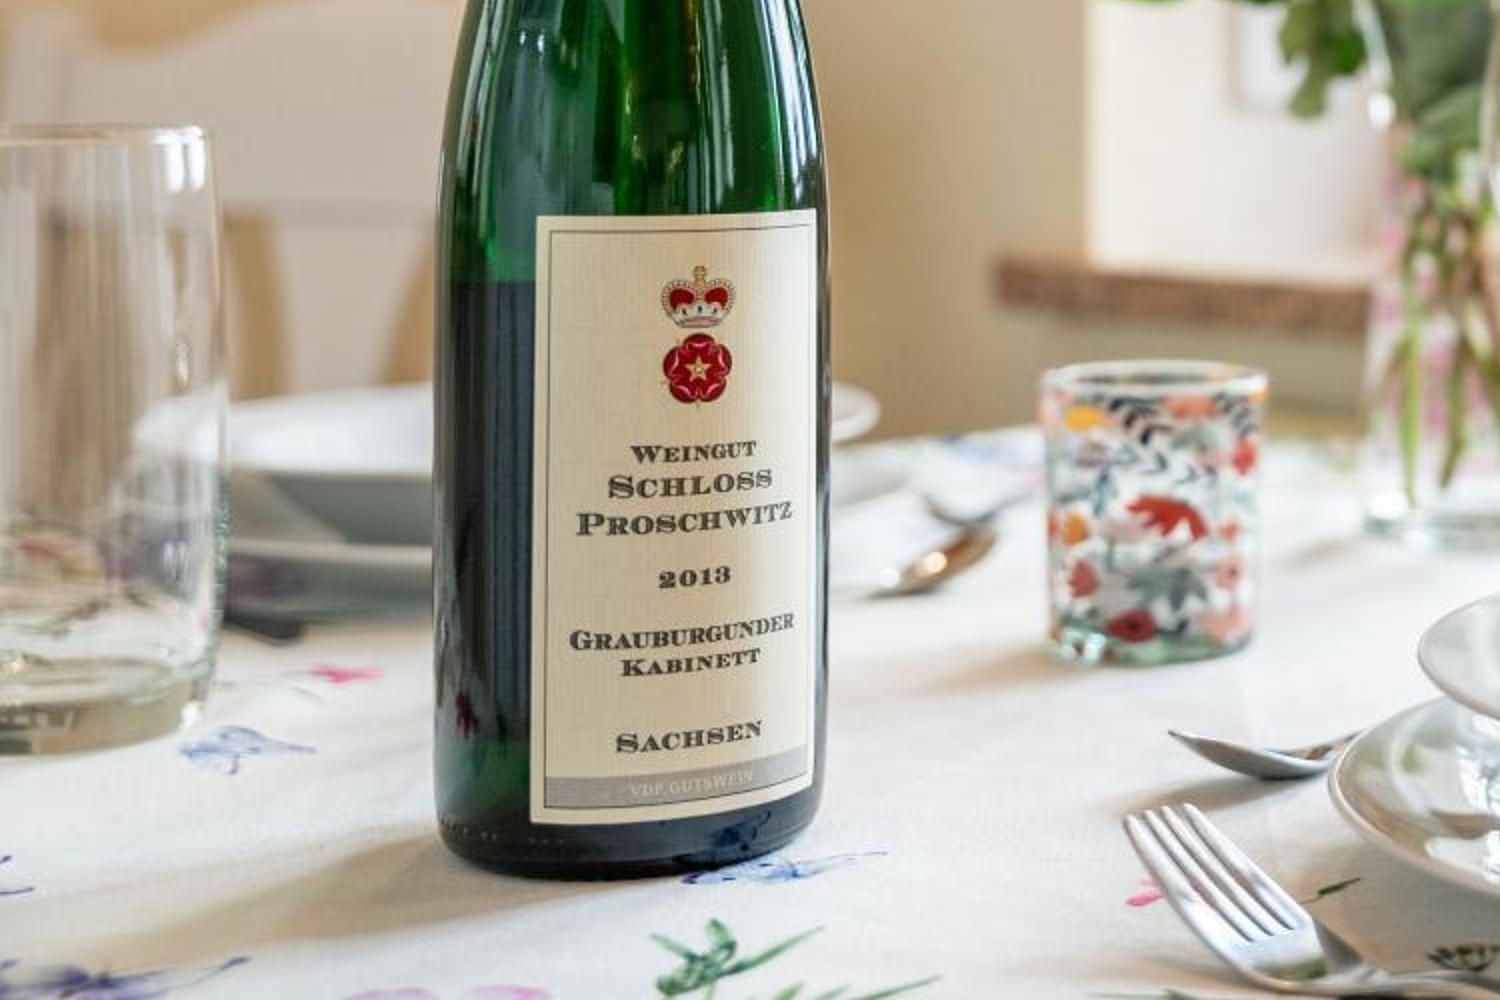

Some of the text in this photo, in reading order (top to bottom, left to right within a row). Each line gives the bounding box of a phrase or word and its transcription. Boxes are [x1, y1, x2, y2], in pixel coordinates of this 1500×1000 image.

[630, 440, 758, 464] WEINGUT
[607, 469, 773, 499] SCHLOSS
[576, 501, 793, 537] PROSCHWITZ
[658, 565, 731, 589] 2013
[568, 612, 795, 651] GRAUBURGUNDER
[620, 648, 761, 677] KABINETT
[615, 720, 763, 754] SACHSEN
